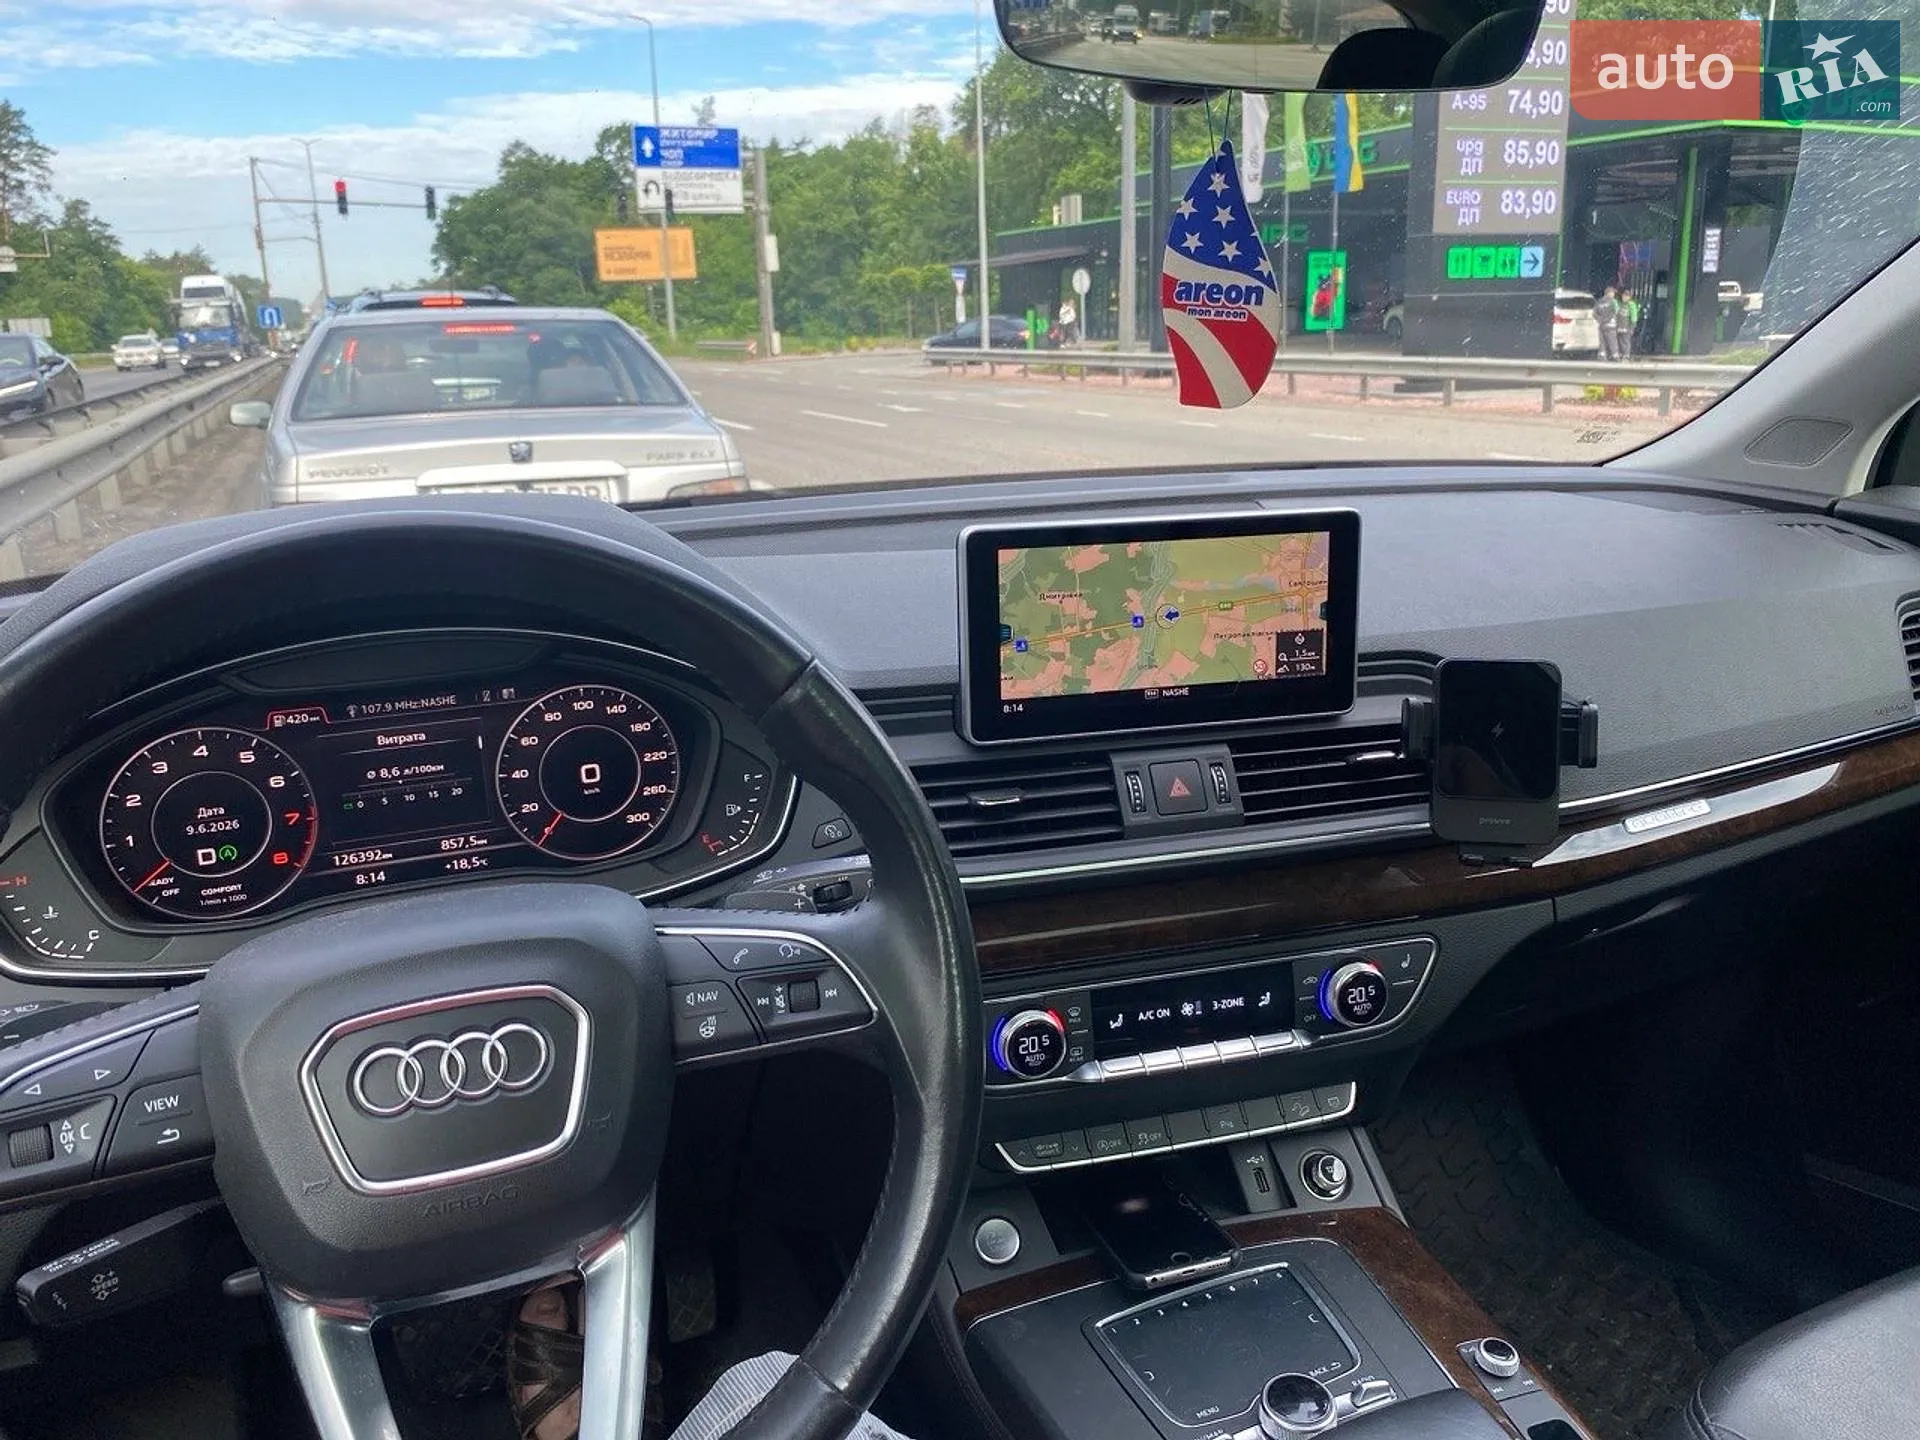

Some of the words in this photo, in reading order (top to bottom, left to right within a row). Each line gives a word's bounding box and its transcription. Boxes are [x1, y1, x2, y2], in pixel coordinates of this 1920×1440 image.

[1451, 93, 1487, 110] A-95
[1508, 89, 1563, 118] 74,90
[1456, 139, 1484, 156] upg
[1503, 139, 1559, 169] 85,90
[1446, 189, 1481, 205] EURO
[1501, 189, 1556, 219] 83,90
[1174, 281, 1264, 306] areon
[1188, 307, 1211, 316] mon
[1214, 309, 1246, 319] areon
[309, 467, 388, 479] PEUGEOT
[1162, 687, 1190, 697] NASHE
[362, 702, 393, 714] 107.9
[572, 701, 594, 711] 100
[606, 704, 627, 715] 140
[1003, 703, 1024, 713] 8:14
[544, 712, 562, 722] 80
[630, 722, 651, 732] 180
[377, 733, 426, 746] Витрата
[521, 736, 539, 746] 60
[192, 745, 209, 758] 4
[239, 751, 255, 763] 5
[643, 751, 668, 762] 220
[151, 762, 168, 774] 3
[379, 766, 401, 779] 8,6
[511, 769, 530, 779] 40
[580, 763, 601, 784] 0
[269, 775, 285, 788] 6
[743, 774, 750, 783] F
[428, 790, 440, 798] 15
[451, 787, 463, 796] 20
[642, 785, 667, 796] 260
[125, 794, 142, 807] 2
[404, 793, 416, 801] 10
[356, 801, 365, 809] 0
[521, 803, 539, 813] 20
[197, 807, 225, 819] Дата
[284, 812, 300, 825] 7
[626, 813, 650, 824] 300
[186, 820, 240, 836] 9.6.2026
[125, 835, 135, 847] 1
[272, 852, 289, 864] 8
[15, 876, 27, 887] H
[356, 871, 386, 885] 8:14
[162, 888, 180, 897] OFF
[201, 884, 242, 896] COMFORT
[229, 894, 248, 903] 1000
[88, 930, 100, 940] C
[697, 991, 719, 1003] NAV
[1212, 997, 1245, 1011] 3-ZONE
[1353, 1002, 1372, 1012] AUTO
[1138, 1010, 1154, 1021] A/C
[1156, 1008, 1170, 1019] ON
[1024, 1053, 1046, 1064] AUTO
[144, 1095, 180, 1113] VIEW
[59, 1130, 76, 1145] OK
[1196, 1405, 1220, 1419] MENU
